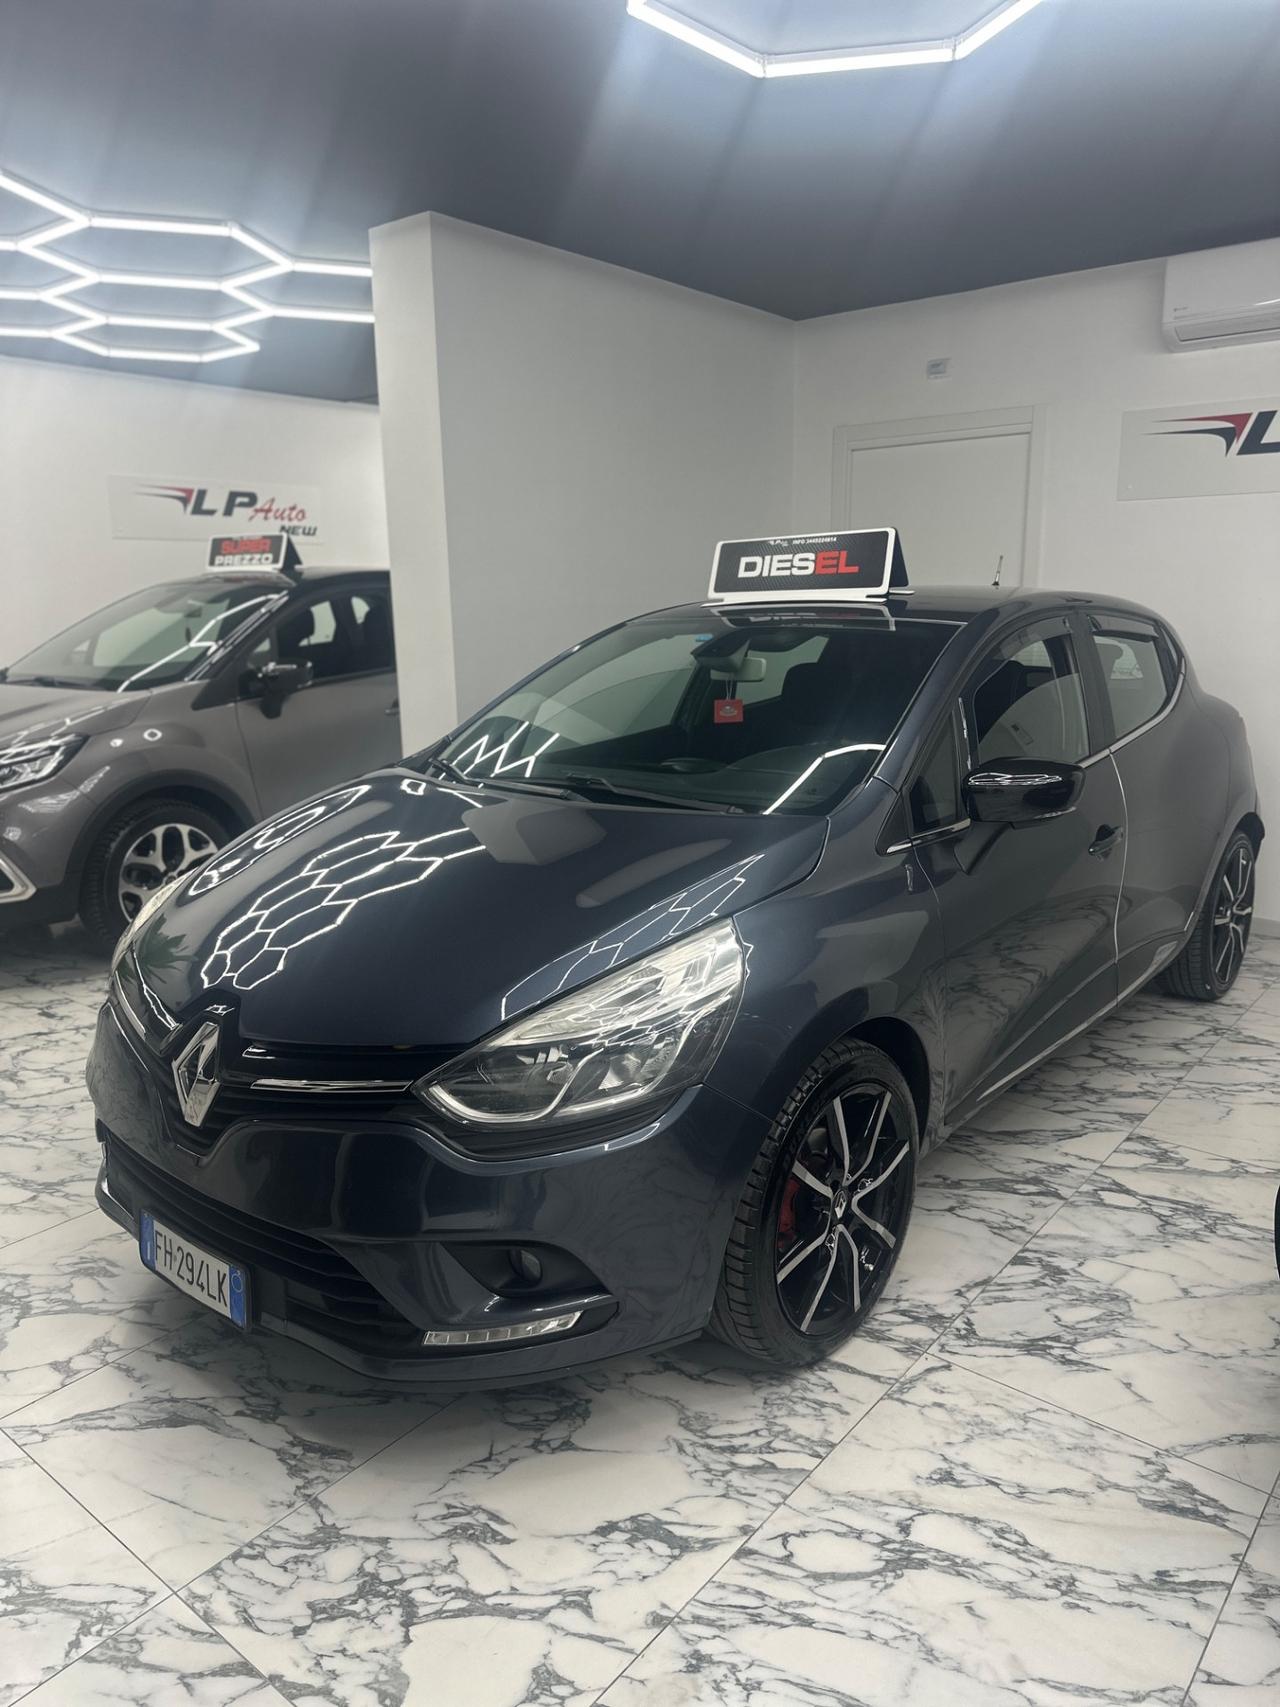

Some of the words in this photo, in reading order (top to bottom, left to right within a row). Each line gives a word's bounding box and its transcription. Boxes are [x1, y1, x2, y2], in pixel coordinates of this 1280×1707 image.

[249, 497, 307, 522] Auto
[279, 525, 318, 536] NEW
[214, 553, 273, 566] PREZZO
[738, 550, 860, 578] DIESEL
